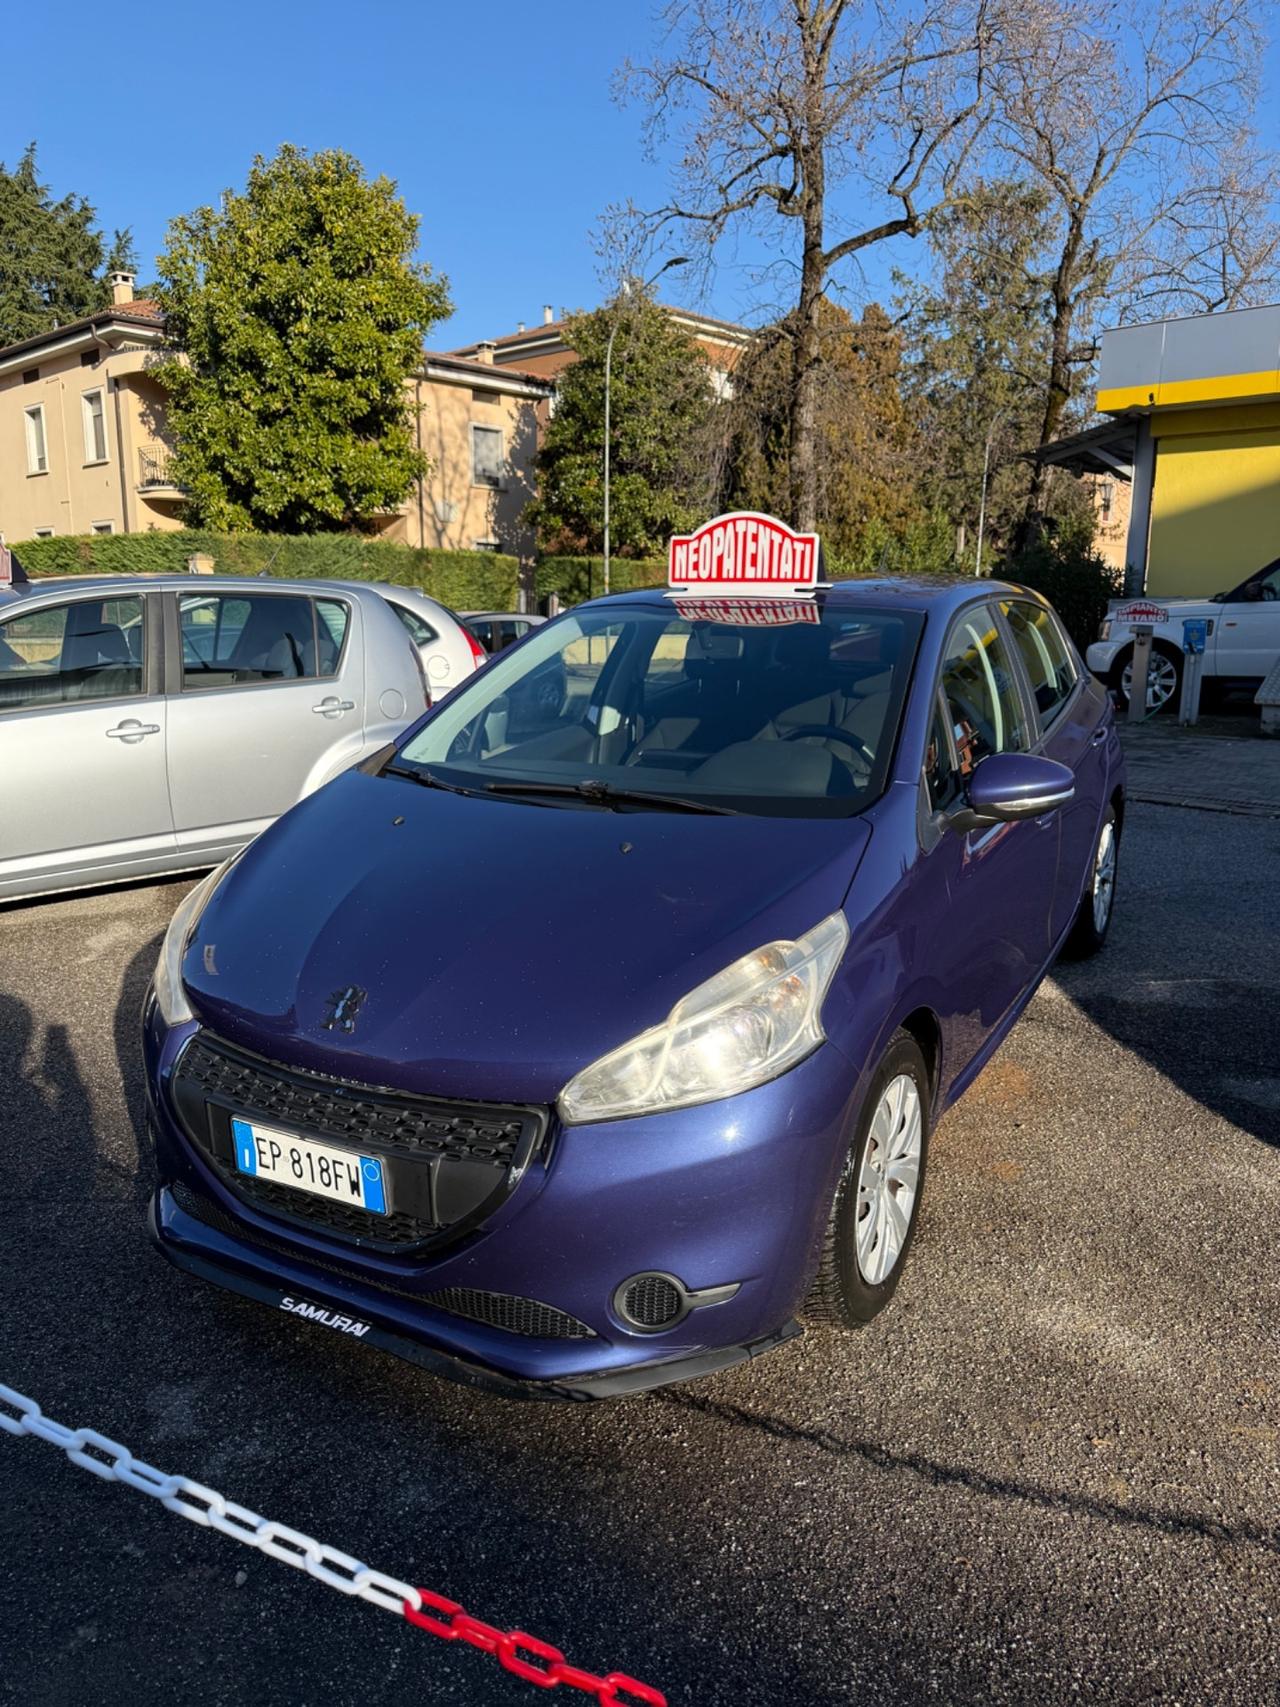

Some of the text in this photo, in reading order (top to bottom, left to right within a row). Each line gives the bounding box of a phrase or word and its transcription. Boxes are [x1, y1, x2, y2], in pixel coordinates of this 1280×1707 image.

[674, 519, 812, 580] NEOPATENTATI
[1118, 614, 1165, 622] METANO
[255, 1136, 362, 1198] EP 818FW
[279, 1296, 371, 1337] SAMURAI
